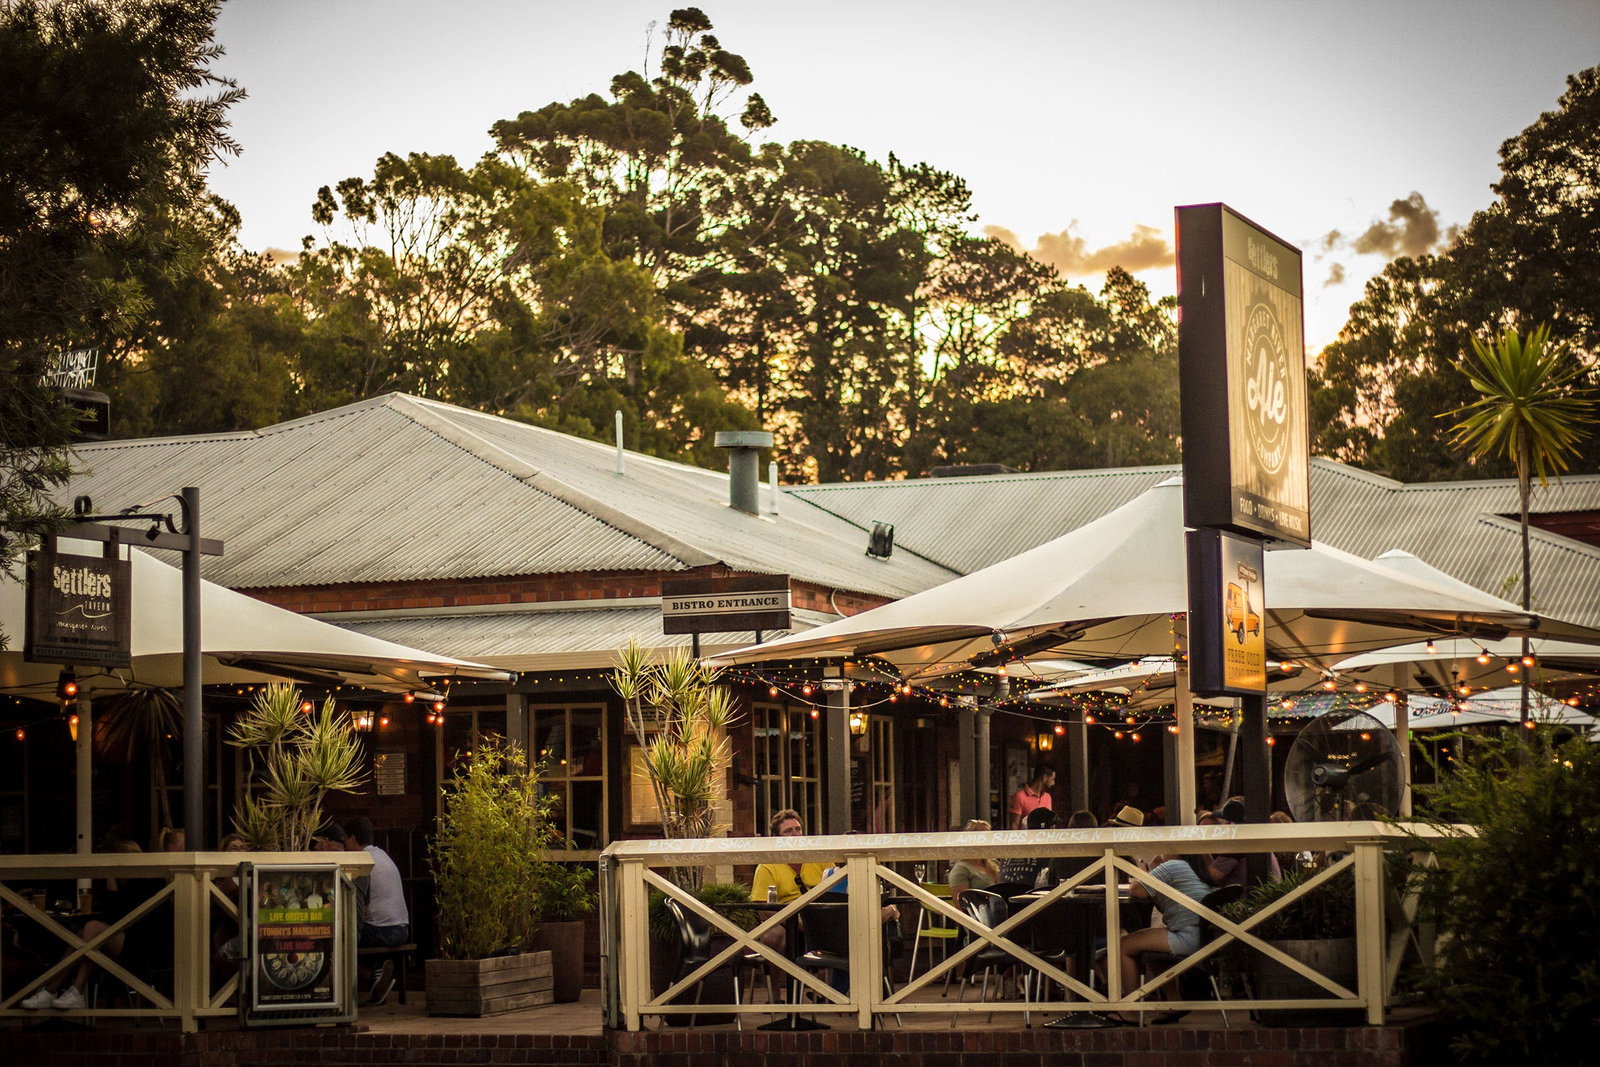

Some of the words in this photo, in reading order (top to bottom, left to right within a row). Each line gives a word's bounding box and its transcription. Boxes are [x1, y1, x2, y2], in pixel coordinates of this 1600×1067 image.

[672, 600, 715, 610] BISTRO
[717, 597, 779, 608] ENTRANCE
[775, 836, 832, 849] BRISKET
[846, 835, 892, 847] PULLED
[945, 832, 986, 844] LAMB
[1035, 829, 1104, 843] CHICKEN
[1169, 825, 1206, 840] EVERY
[1213, 824, 1240, 840] DAY
[269, 912, 283, 921] LIVE
